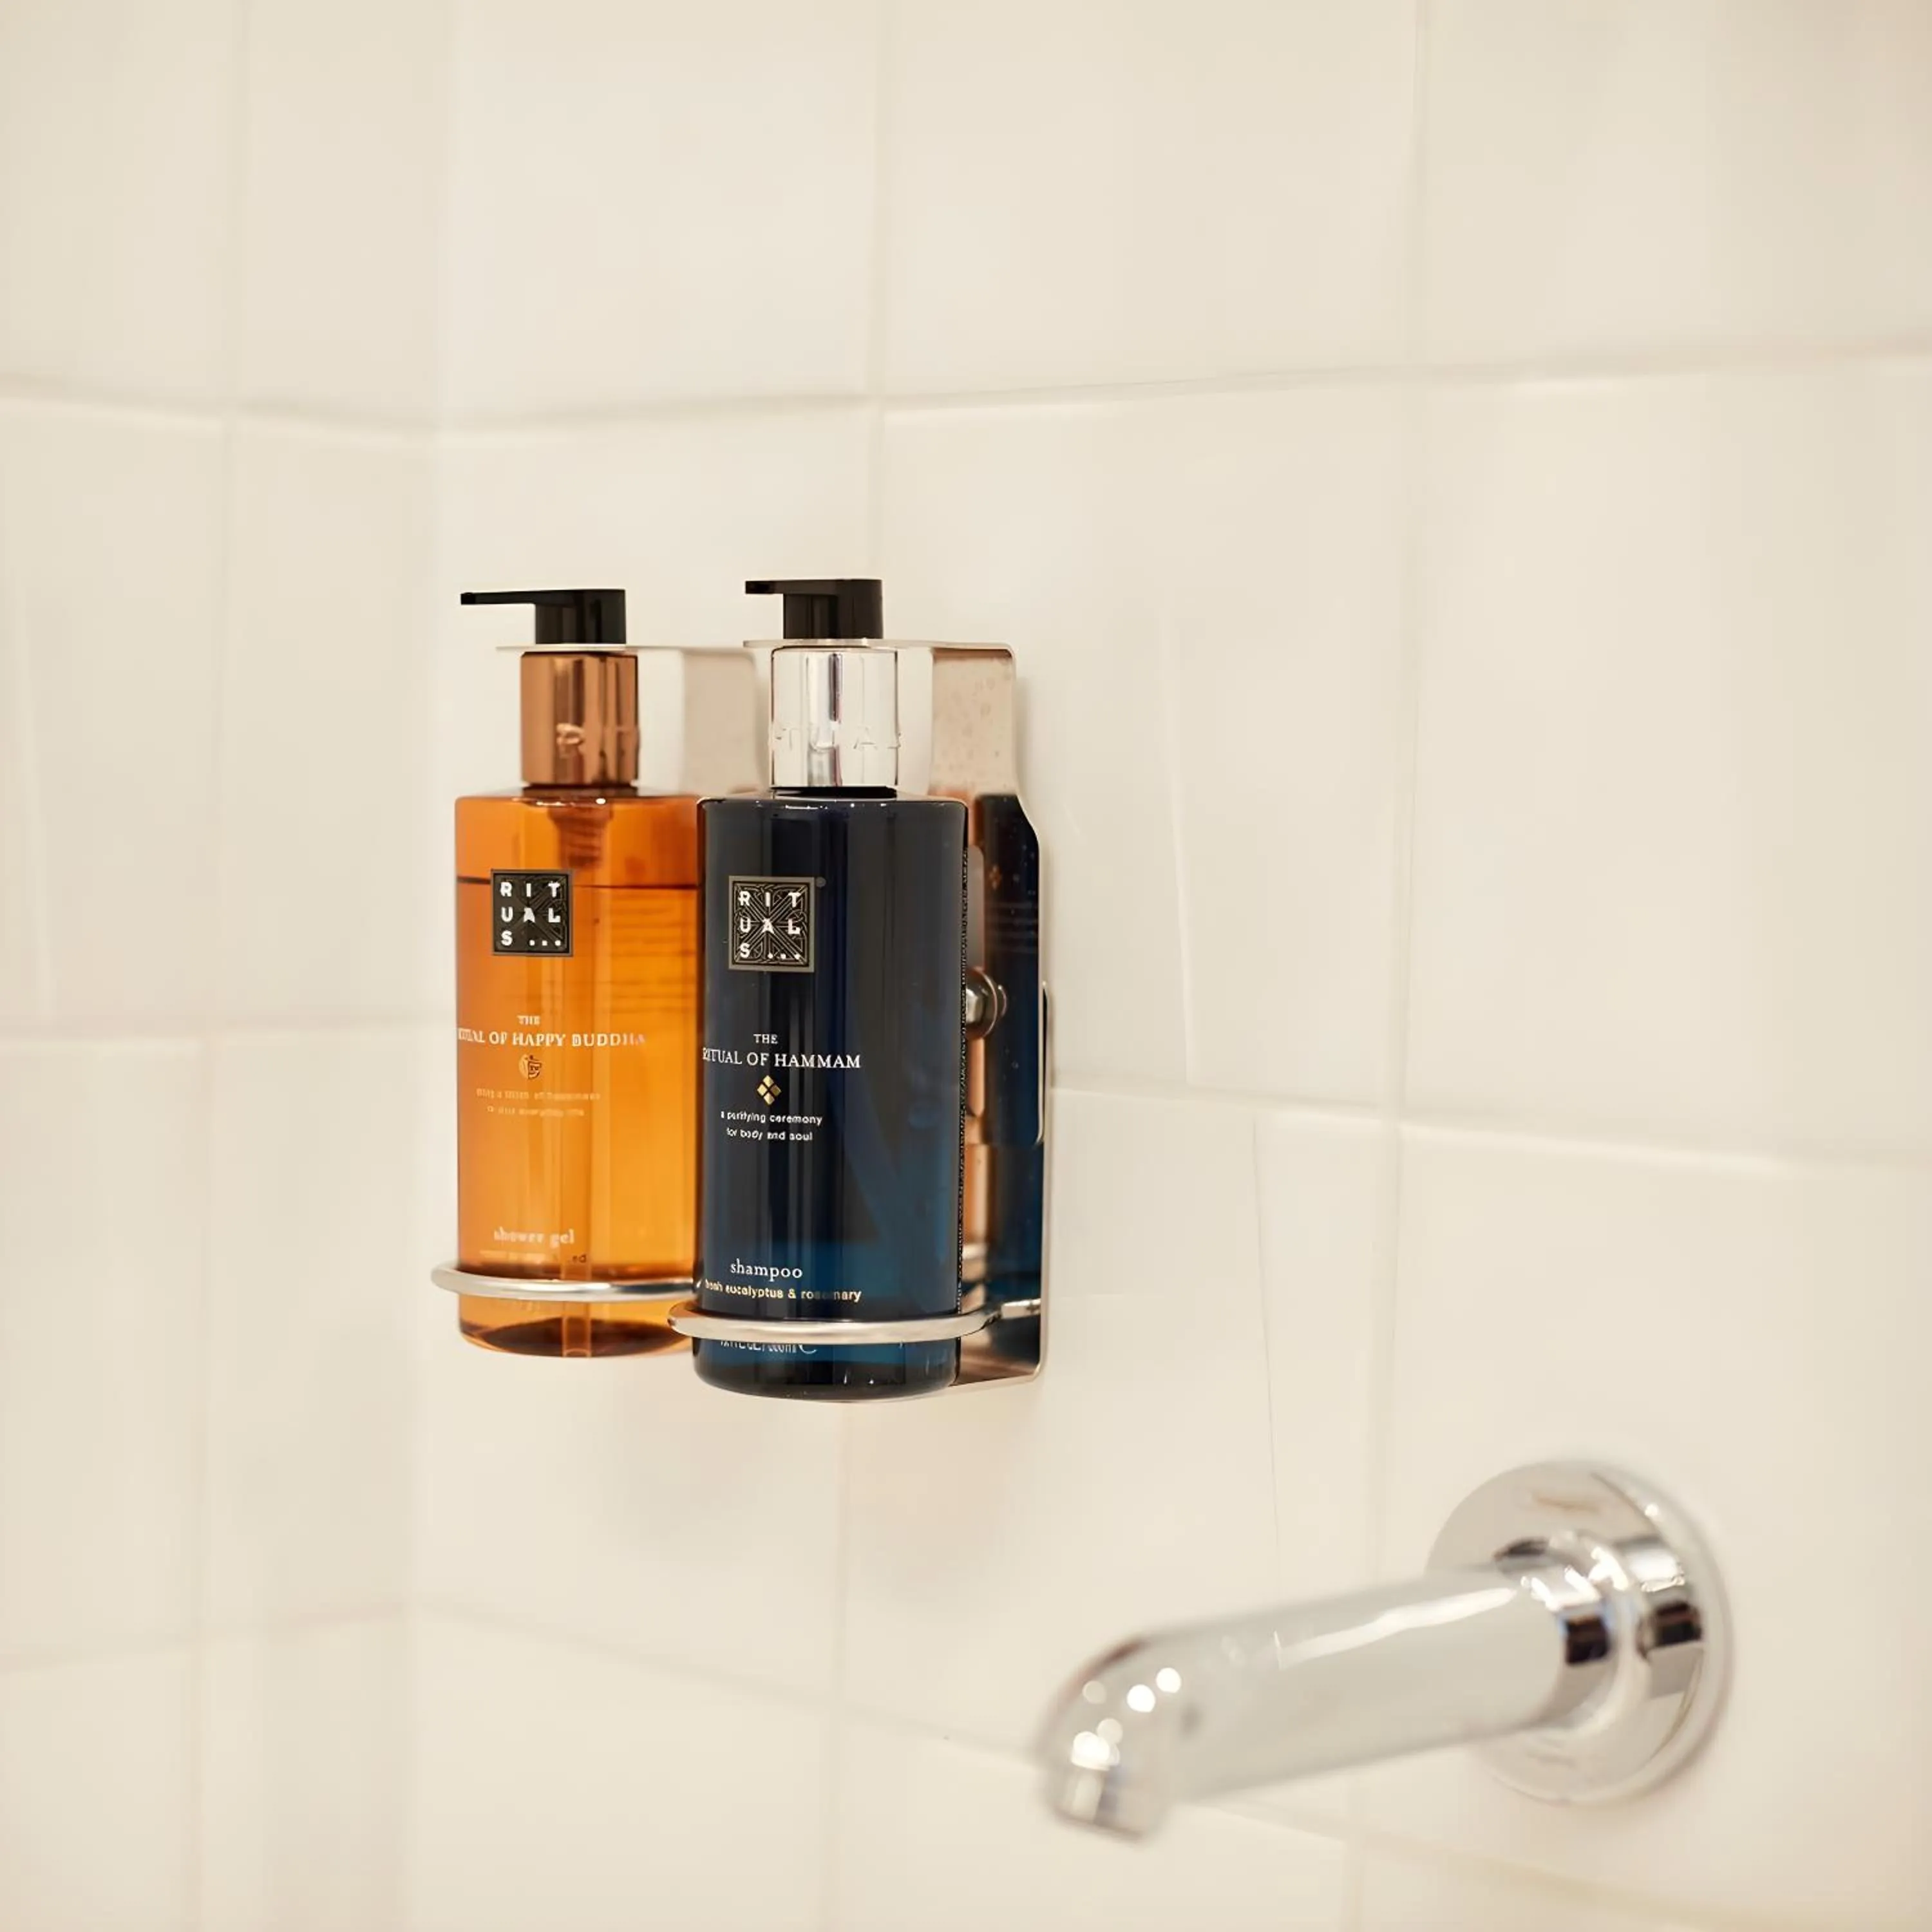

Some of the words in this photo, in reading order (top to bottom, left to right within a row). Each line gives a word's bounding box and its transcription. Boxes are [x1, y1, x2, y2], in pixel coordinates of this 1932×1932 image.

[517, 1015, 540, 1025] THE
[458, 1028, 485, 1043] TUAL
[489, 1031, 507, 1045] OF
[512, 1032, 566, 1047] HAPPY
[753, 1034, 778, 1044] THE
[746, 1052, 770, 1066] OF
[774, 1053, 862, 1069] HAMMAM
[727, 1111, 766, 1124] purifying
[770, 1115, 822, 1126] ceremony
[726, 1127, 737, 1137] for
[740, 1129, 763, 1141] body
[767, 1132, 786, 1141] and
[789, 1132, 813, 1141] soul
[493, 1226, 545, 1243] shower
[549, 1228, 574, 1249] gel
[730, 1258, 803, 1282] shampoo
[725, 1285, 784, 1299] eucalyptus
[788, 1288, 797, 1299] &
[800, 1290, 862, 1303] romary
